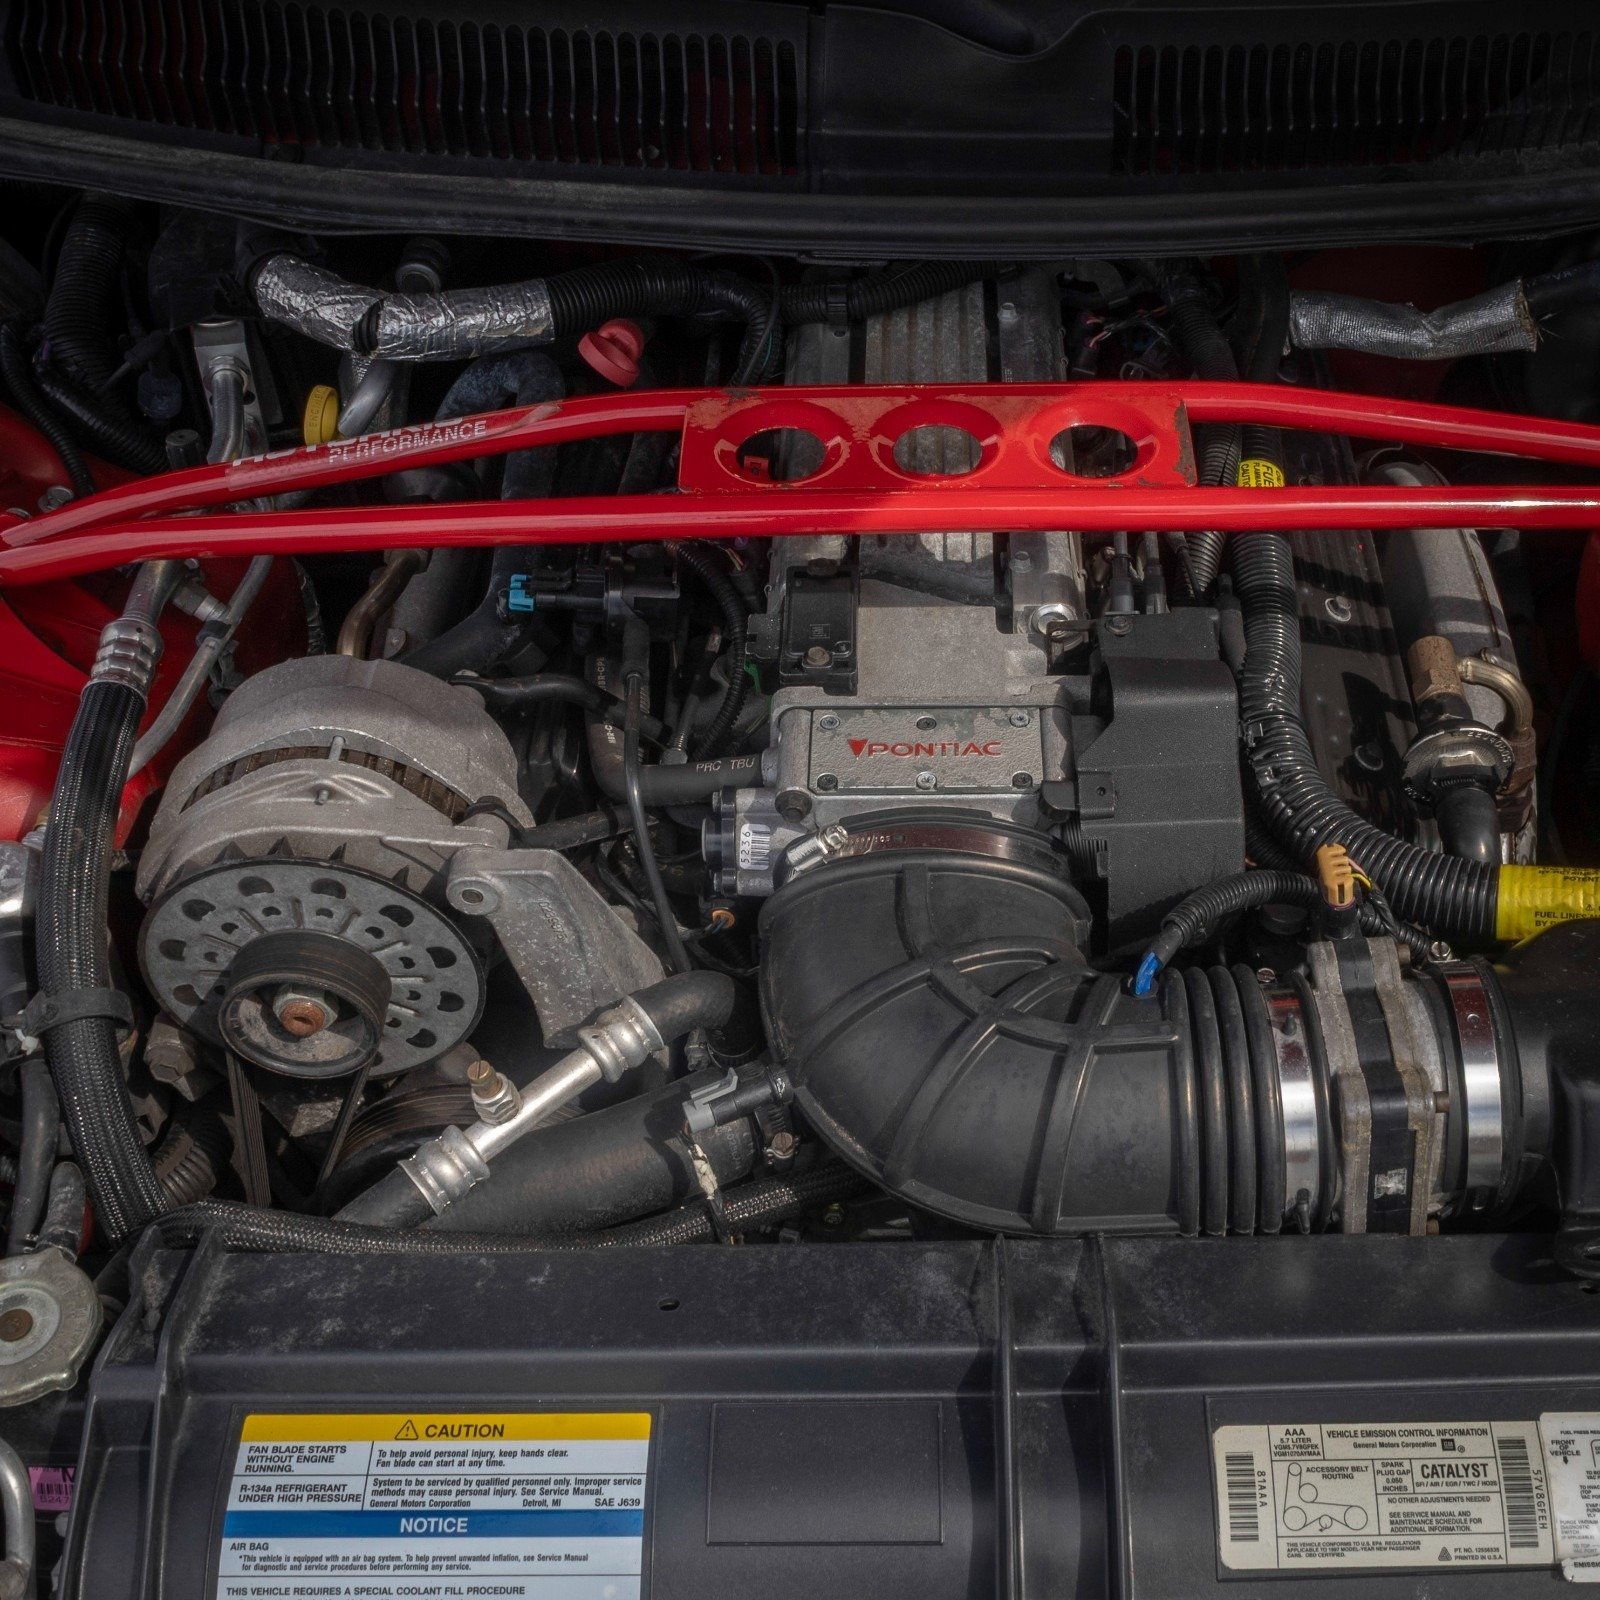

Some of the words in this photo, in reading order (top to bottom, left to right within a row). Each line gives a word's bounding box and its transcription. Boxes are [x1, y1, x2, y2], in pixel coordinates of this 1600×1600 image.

[328, 420, 487, 464] PERFORMANCE
[1241, 463, 1251, 487] CAUTIO
[1261, 464, 1275, 487] FUE
[866, 740, 1003, 758] PONTIAC
[695, 760, 722, 773] PRC
[730, 757, 756, 771] TBU
[740, 827, 753, 865] 5236
[1534, 911, 1558, 919] FUEL
[425, 1424, 505, 1438] CAUTION
[1284, 1428, 1306, 1436] AAA
[1326, 1430, 1359, 1438] VEHICLE
[1360, 1430, 1397, 1438] EMISSION
[1398, 1429, 1435, 1437] CONTROL
[1436, 1428, 1488, 1437] INFORMATION
[248, 1446, 269, 1454] FAN
[271, 1446, 305, 1454] BLADE
[308, 1445, 347, 1454] STARTS
[1401, 1441, 1437, 1449] Corporation
[247, 1455, 294, 1463] WITHOUT
[296, 1455, 335, 1463] ENGINE
[378, 1449, 387, 1458] To
[389, 1449, 407, 1459] help
[410, 1449, 431, 1458] avoid
[434, 1449, 469, 1459] personal
[471, 1449, 496, 1459] injury,
[498, 1449, 518, 1458] keep
[520, 1449, 544, 1457] hands
[547, 1449, 569, 1457] clear.
[376, 1459, 390, 1468] Fan
[393, 1459, 416, 1467] blade
[436, 1459, 455, 1467] start
[457, 1459, 466, 1467] at
[468, 1460, 485, 1468] any
[485, 1459, 505, 1467] time.
[244, 1465, 294, 1473] RUNNING.
[1420, 1463, 1489, 1479] CATALYST
[372, 1478, 402, 1488] System
[404, 1478, 412, 1486] to
[415, 1478, 425, 1486] be
[427, 1478, 461, 1486] serviced
[463, 1478, 473, 1487] by
[475, 1477, 510, 1487] qualified
[512, 1477, 552, 1487] personnel
[553, 1477, 572, 1487] only.
[574, 1477, 610, 1487] Improper
[613, 1477, 642, 1485] service
[240, 1484, 272, 1492] R-134a
[275, 1484, 348, 1492] REFRIGERANT
[371, 1488, 406, 1496] methods
[408, 1489, 426, 1497] may
[455, 1487, 490, 1497] personal
[492, 1487, 518, 1497] injury.
[520, 1487, 536, 1496] See
[539, 1487, 569, 1496] Service
[572, 1487, 604, 1496] Manual.
[238, 1494, 274, 1503] UNDER
[276, 1494, 304, 1502] HIGH
[306, 1494, 362, 1502] PRESSURE
[522, 1499, 549, 1508] Detroit,
[551, 1499, 561, 1507] MI
[594, 1498, 614, 1507] SAE
[617, 1498, 640, 1507] J639
[1532, 1469, 1548, 1530] 57V8GFEH
[369, 1499, 398, 1508] General
[400, 1499, 426, 1508] Motors
[428, 1499, 471, 1509] Corporation
[1389, 1511, 1401, 1519] SEE
[400, 1517, 469, 1533] NOTICE
[1389, 1518, 1434, 1526] MAINTENANCE
[230, 1542, 247, 1551] AIR
[249, 1542, 269, 1551] BAG
[259, 1554, 282, 1562] vehicle
[292, 1554, 323, 1563] equipped
[325, 1554, 339, 1562] with
[352, 1554, 361, 1562] air
[363, 1554, 376, 1563] bag
[378, 1554, 403, 1563] system.
[405, 1554, 414, 1562] To
[415, 1554, 430, 1562] help
[431, 1554, 457, 1562] prevent
[492, 1554, 521, 1562] inflation,
[537, 1553, 561, 1562] Service
[564, 1553, 589, 1561] Manual
[242, 1563, 251, 1571] for
[253, 1563, 287, 1572] diagnostic
[289, 1563, 302, 1571] and
[304, 1563, 328, 1571] service
[330, 1563, 367, 1572] procedures
[392, 1563, 428, 1572] performing
[1573, 1561, 1600, 1569] EMISSIO
[226, 1587, 248, 1596] THIS
[250, 1587, 290, 1596] VEHICLE
[293, 1587, 341, 1596] REQUIRES
[344, 1587, 351, 1595] A
[354, 1587, 393, 1595] SPECIAL
[396, 1586, 442, 1595] COOLANT
[444, 1586, 463, 1595] FILL
[466, 1586, 525, 1595] PROCEDURE
